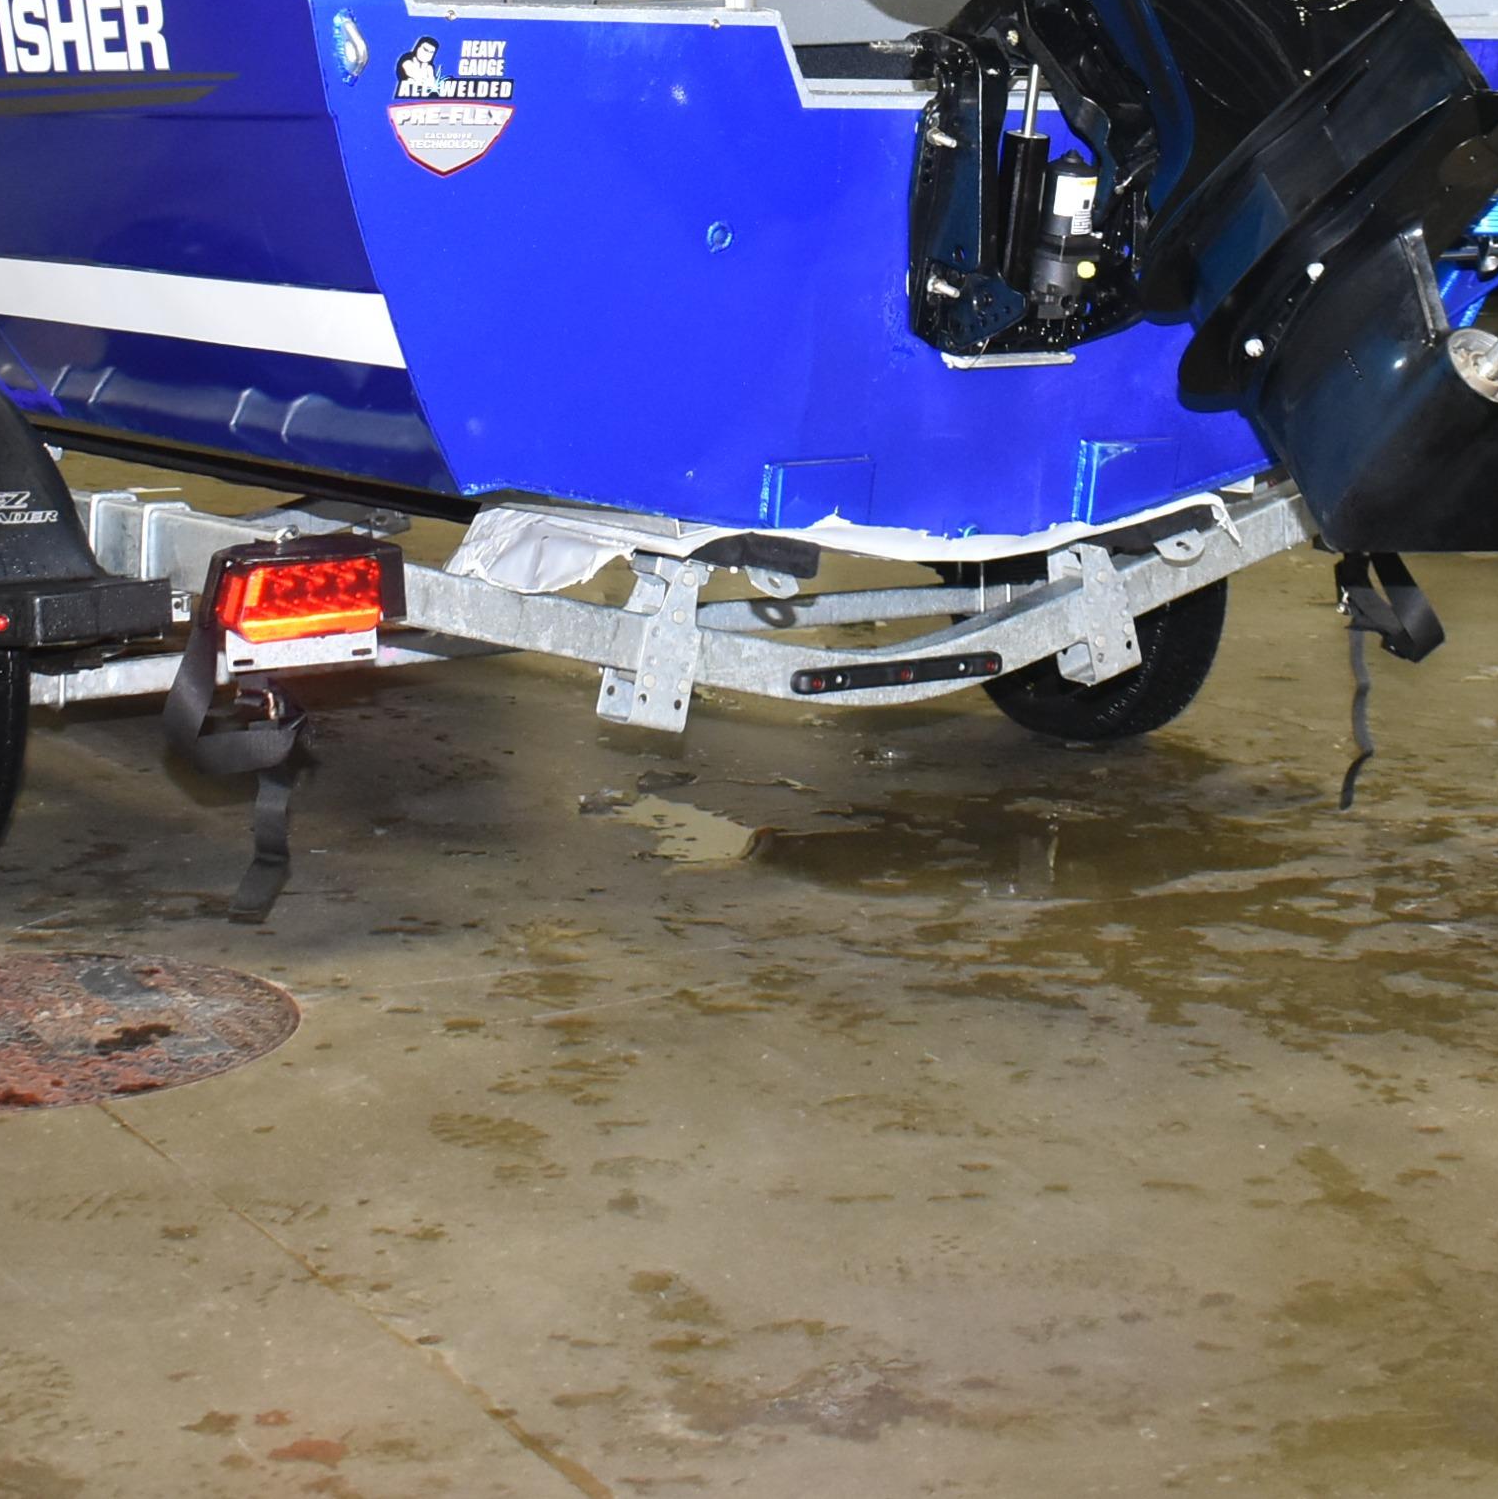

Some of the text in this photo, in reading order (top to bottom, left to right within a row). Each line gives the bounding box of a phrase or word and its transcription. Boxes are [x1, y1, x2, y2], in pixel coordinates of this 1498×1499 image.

[460, 40, 506, 58] HEAVY
[458, 59, 505, 76] GAUGE
[438, 80, 513, 99] WELDED
[396, 107, 503, 126] PRE-FLEX
[408, 139, 486, 150] TECHNOLOGY
